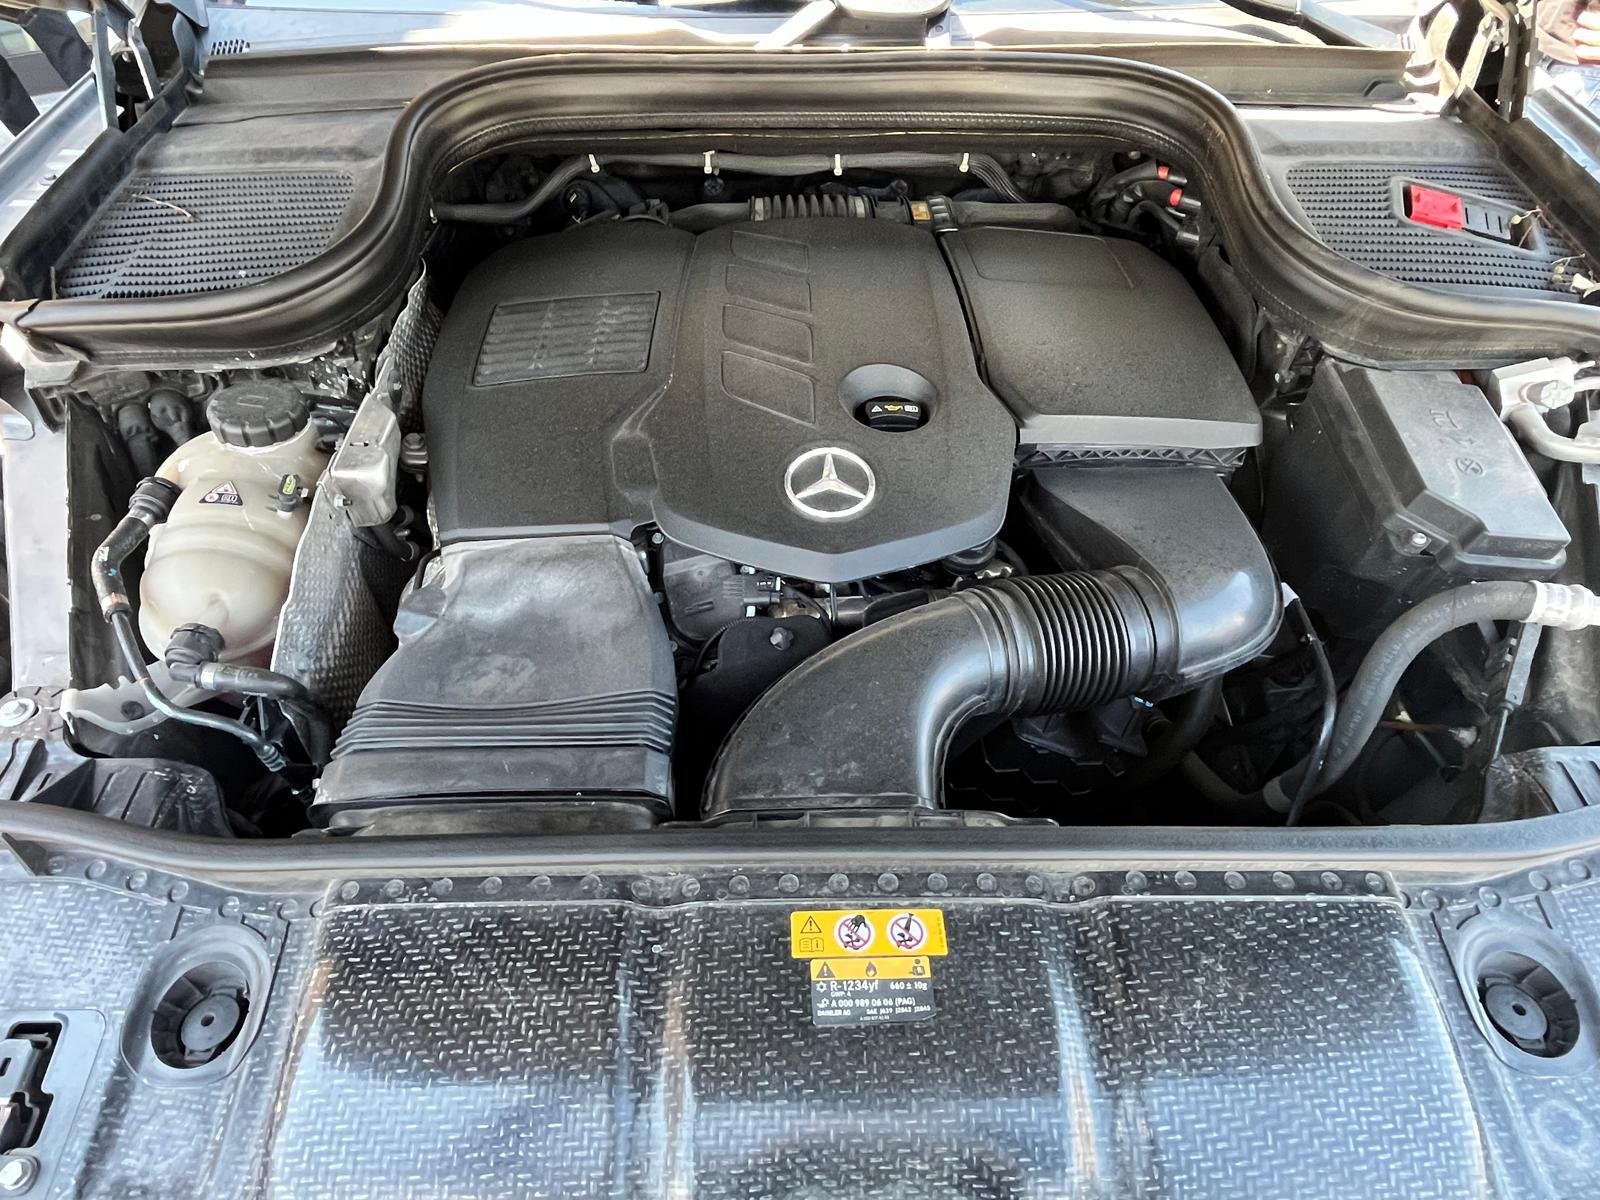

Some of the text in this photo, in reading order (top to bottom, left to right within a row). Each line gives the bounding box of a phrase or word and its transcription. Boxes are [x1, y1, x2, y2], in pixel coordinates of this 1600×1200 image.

[830, 980, 879, 993] R-1234yf
[914, 981, 928, 991] 10g
[830, 999, 837, 1007] A
[838, 998, 853, 1007] 000
[895, 997, 916, 1007] (PAG)
